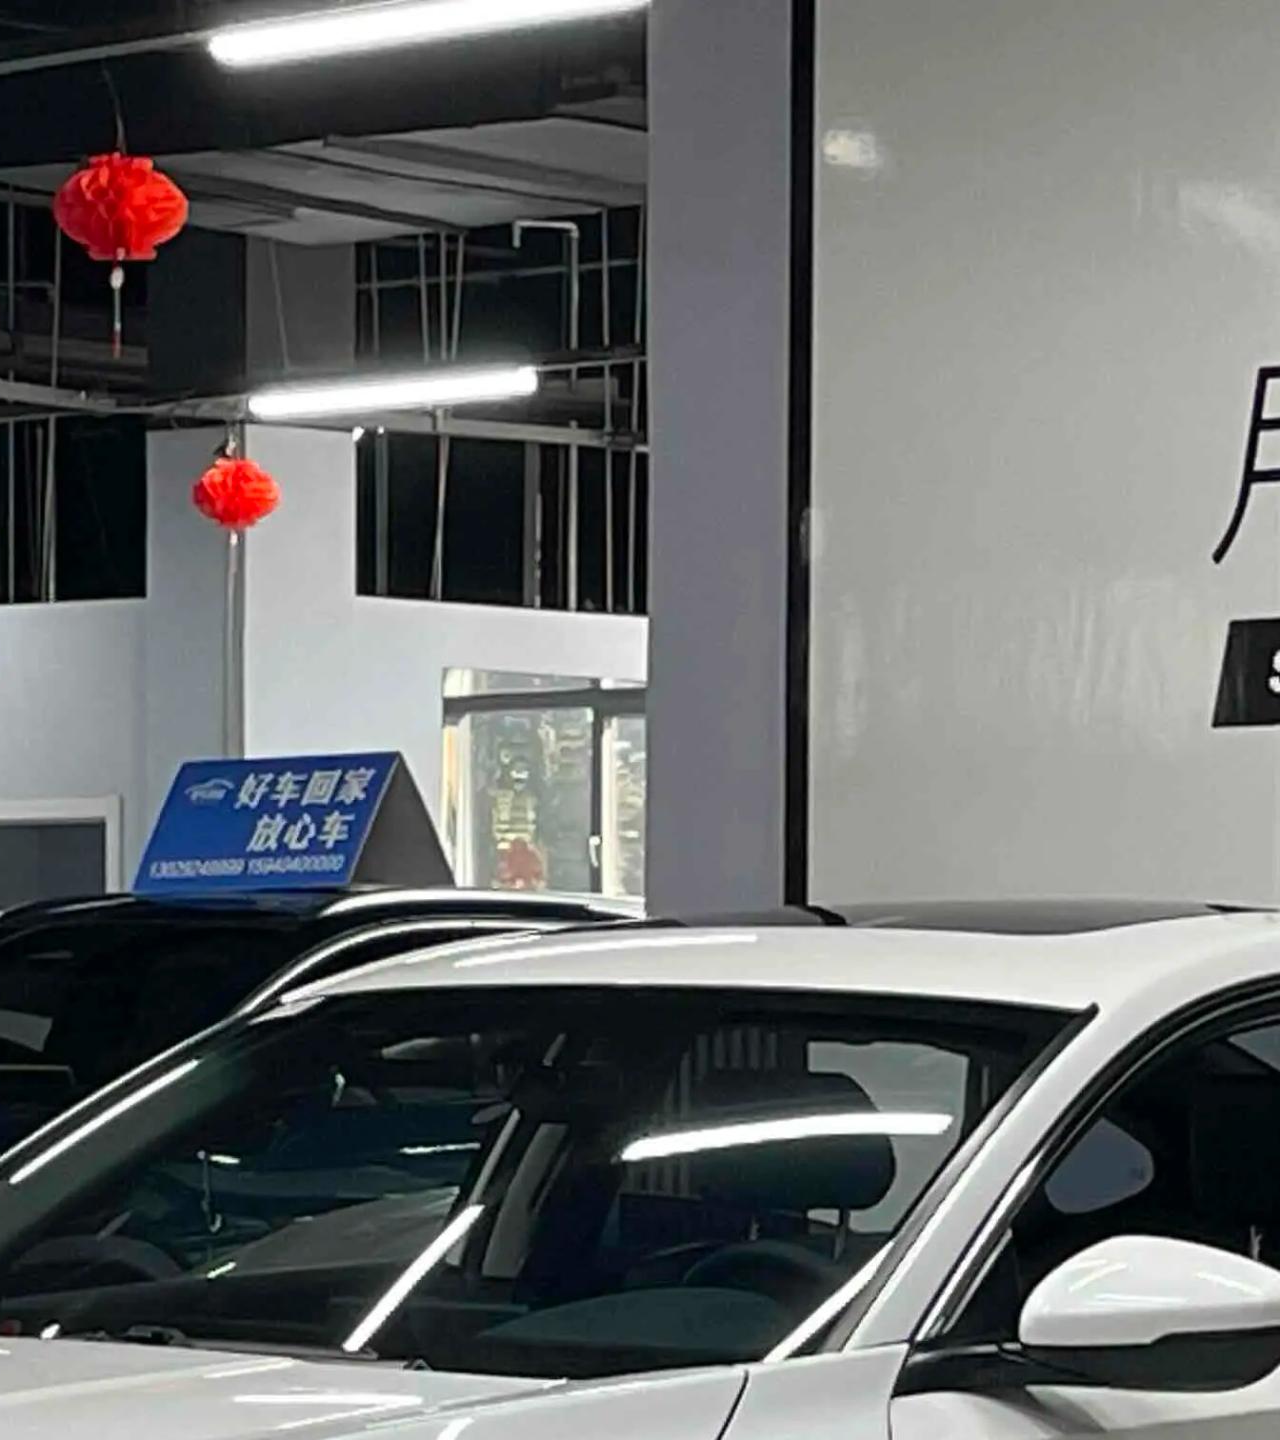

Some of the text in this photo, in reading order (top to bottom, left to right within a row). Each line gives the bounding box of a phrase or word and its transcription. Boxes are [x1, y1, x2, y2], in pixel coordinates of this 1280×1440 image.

[233, 767, 376, 809] 好车回家
[246, 810, 355, 853] 放心车
